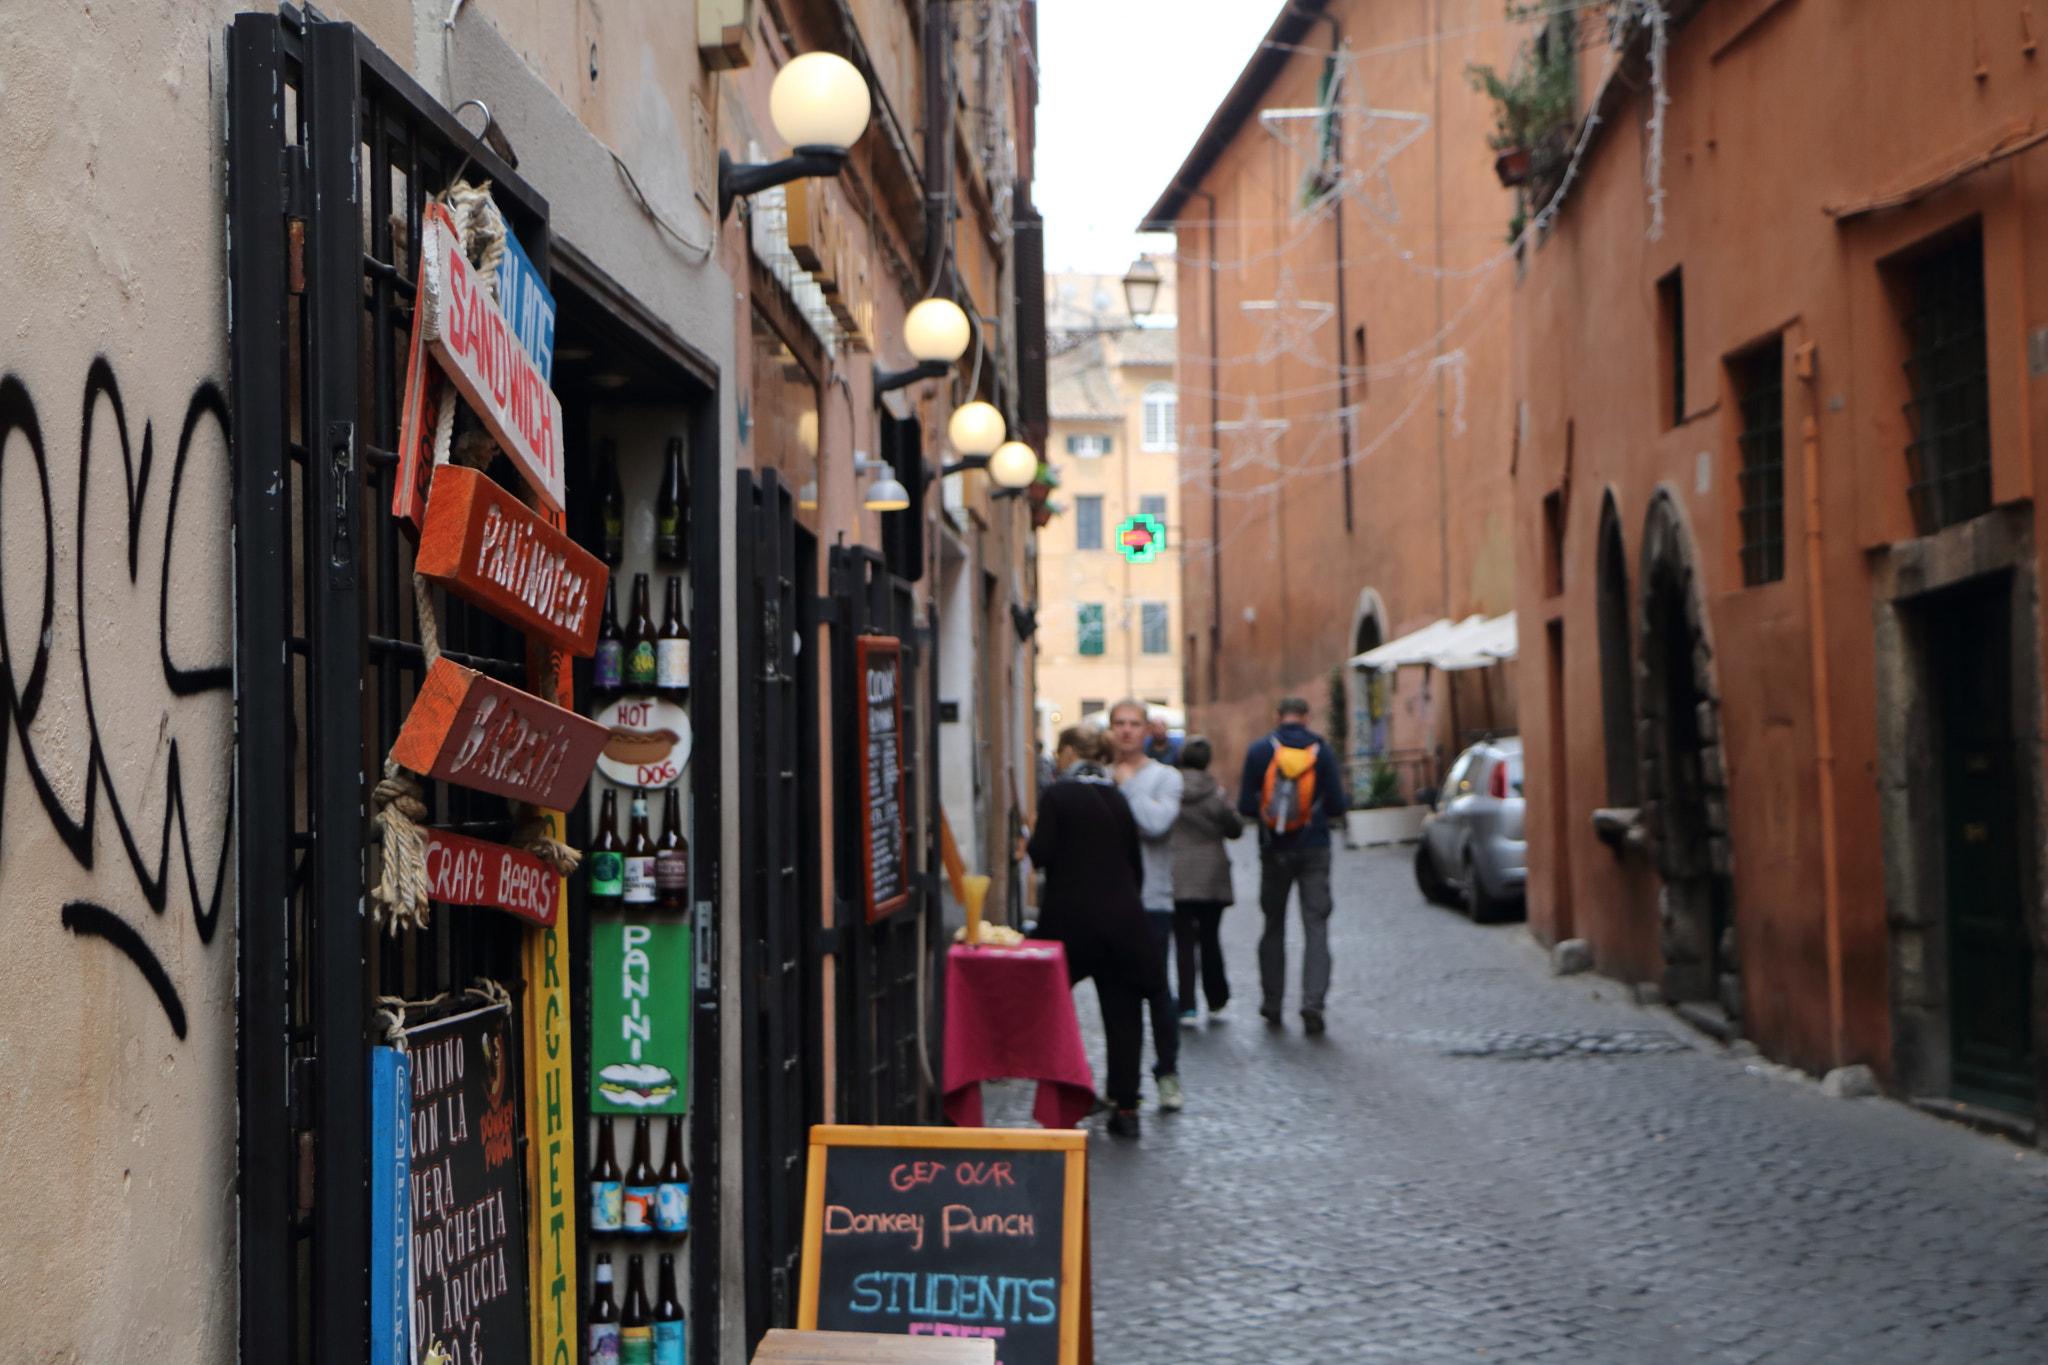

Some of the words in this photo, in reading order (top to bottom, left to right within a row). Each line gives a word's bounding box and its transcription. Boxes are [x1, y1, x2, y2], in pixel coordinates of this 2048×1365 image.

[450, 247, 554, 479] SANDWICH
[618, 703, 653, 727] HOT
[637, 762, 677, 786] DOG
[623, 925, 650, 1060] PANINI
[410, 1099, 439, 1162] CON
[447, 1089, 468, 1146] LA
[410, 1155, 454, 1226] VERA
[890, 1161, 946, 1191] GET
[956, 1161, 1015, 1188] OUR
[414, 1186, 506, 1291] PORCHETTA
[825, 1204, 924, 1251] Donkey
[417, 1291, 433, 1351] DI
[442, 1243, 508, 1333] ARICCIA
[850, 1270, 1057, 1325] STUDENTS
